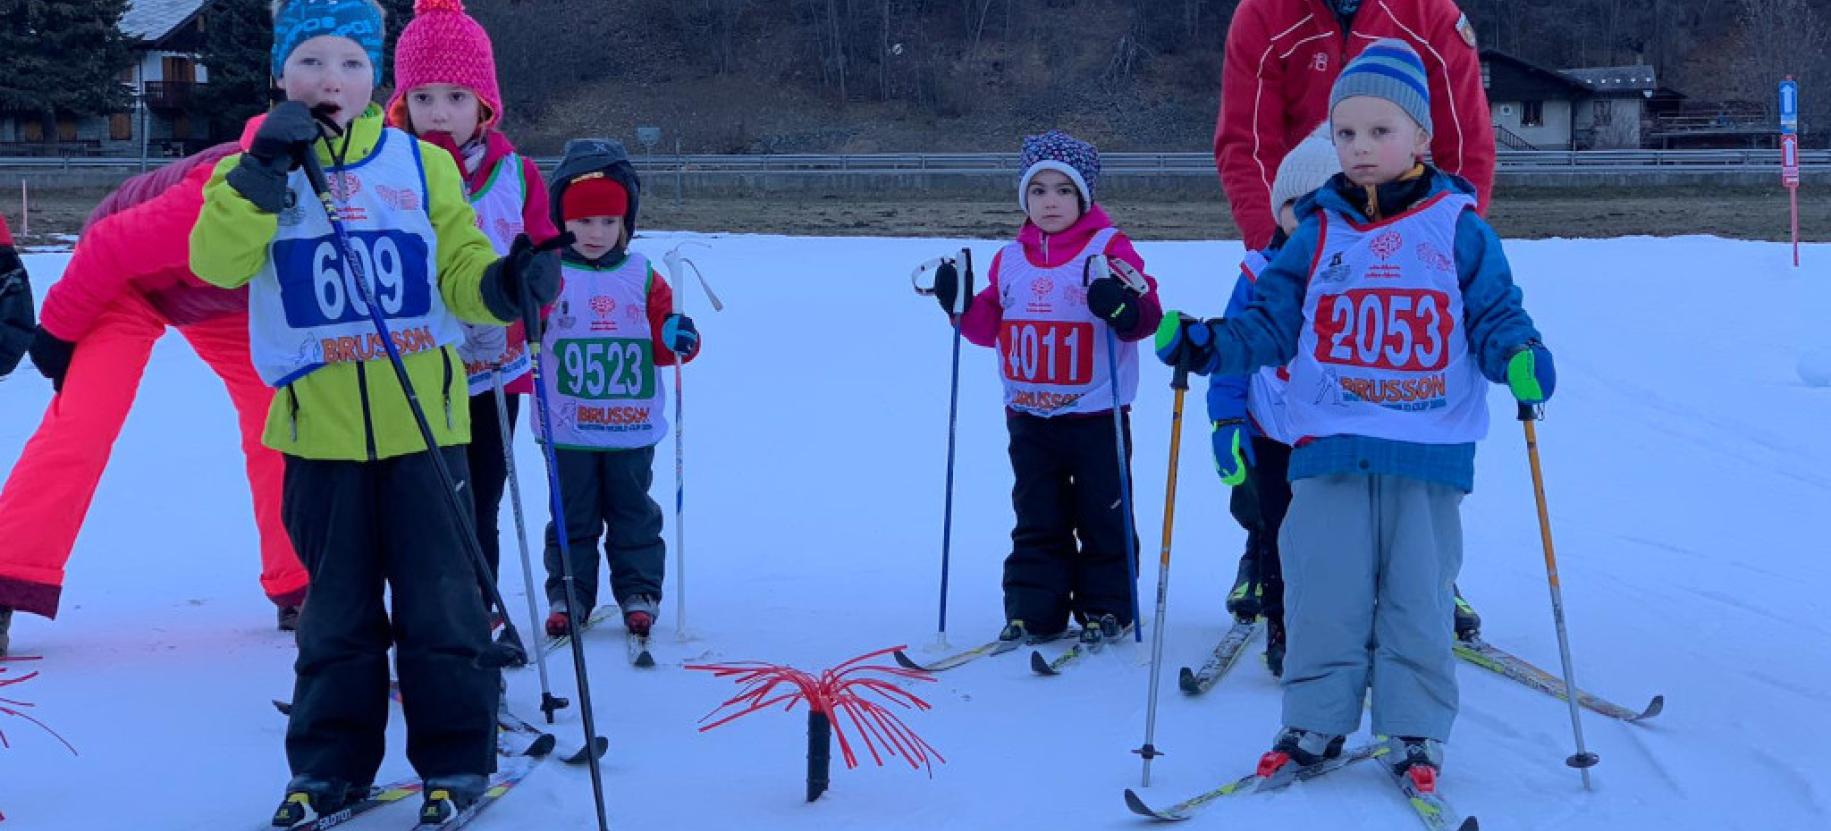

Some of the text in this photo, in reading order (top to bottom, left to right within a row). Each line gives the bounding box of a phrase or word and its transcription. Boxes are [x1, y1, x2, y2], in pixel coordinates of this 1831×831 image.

[312, 236, 404, 320] 609
[1010, 325, 1079, 380] 4011
[1330, 294, 1442, 367] 2053
[564, 342, 643, 396] 9523
